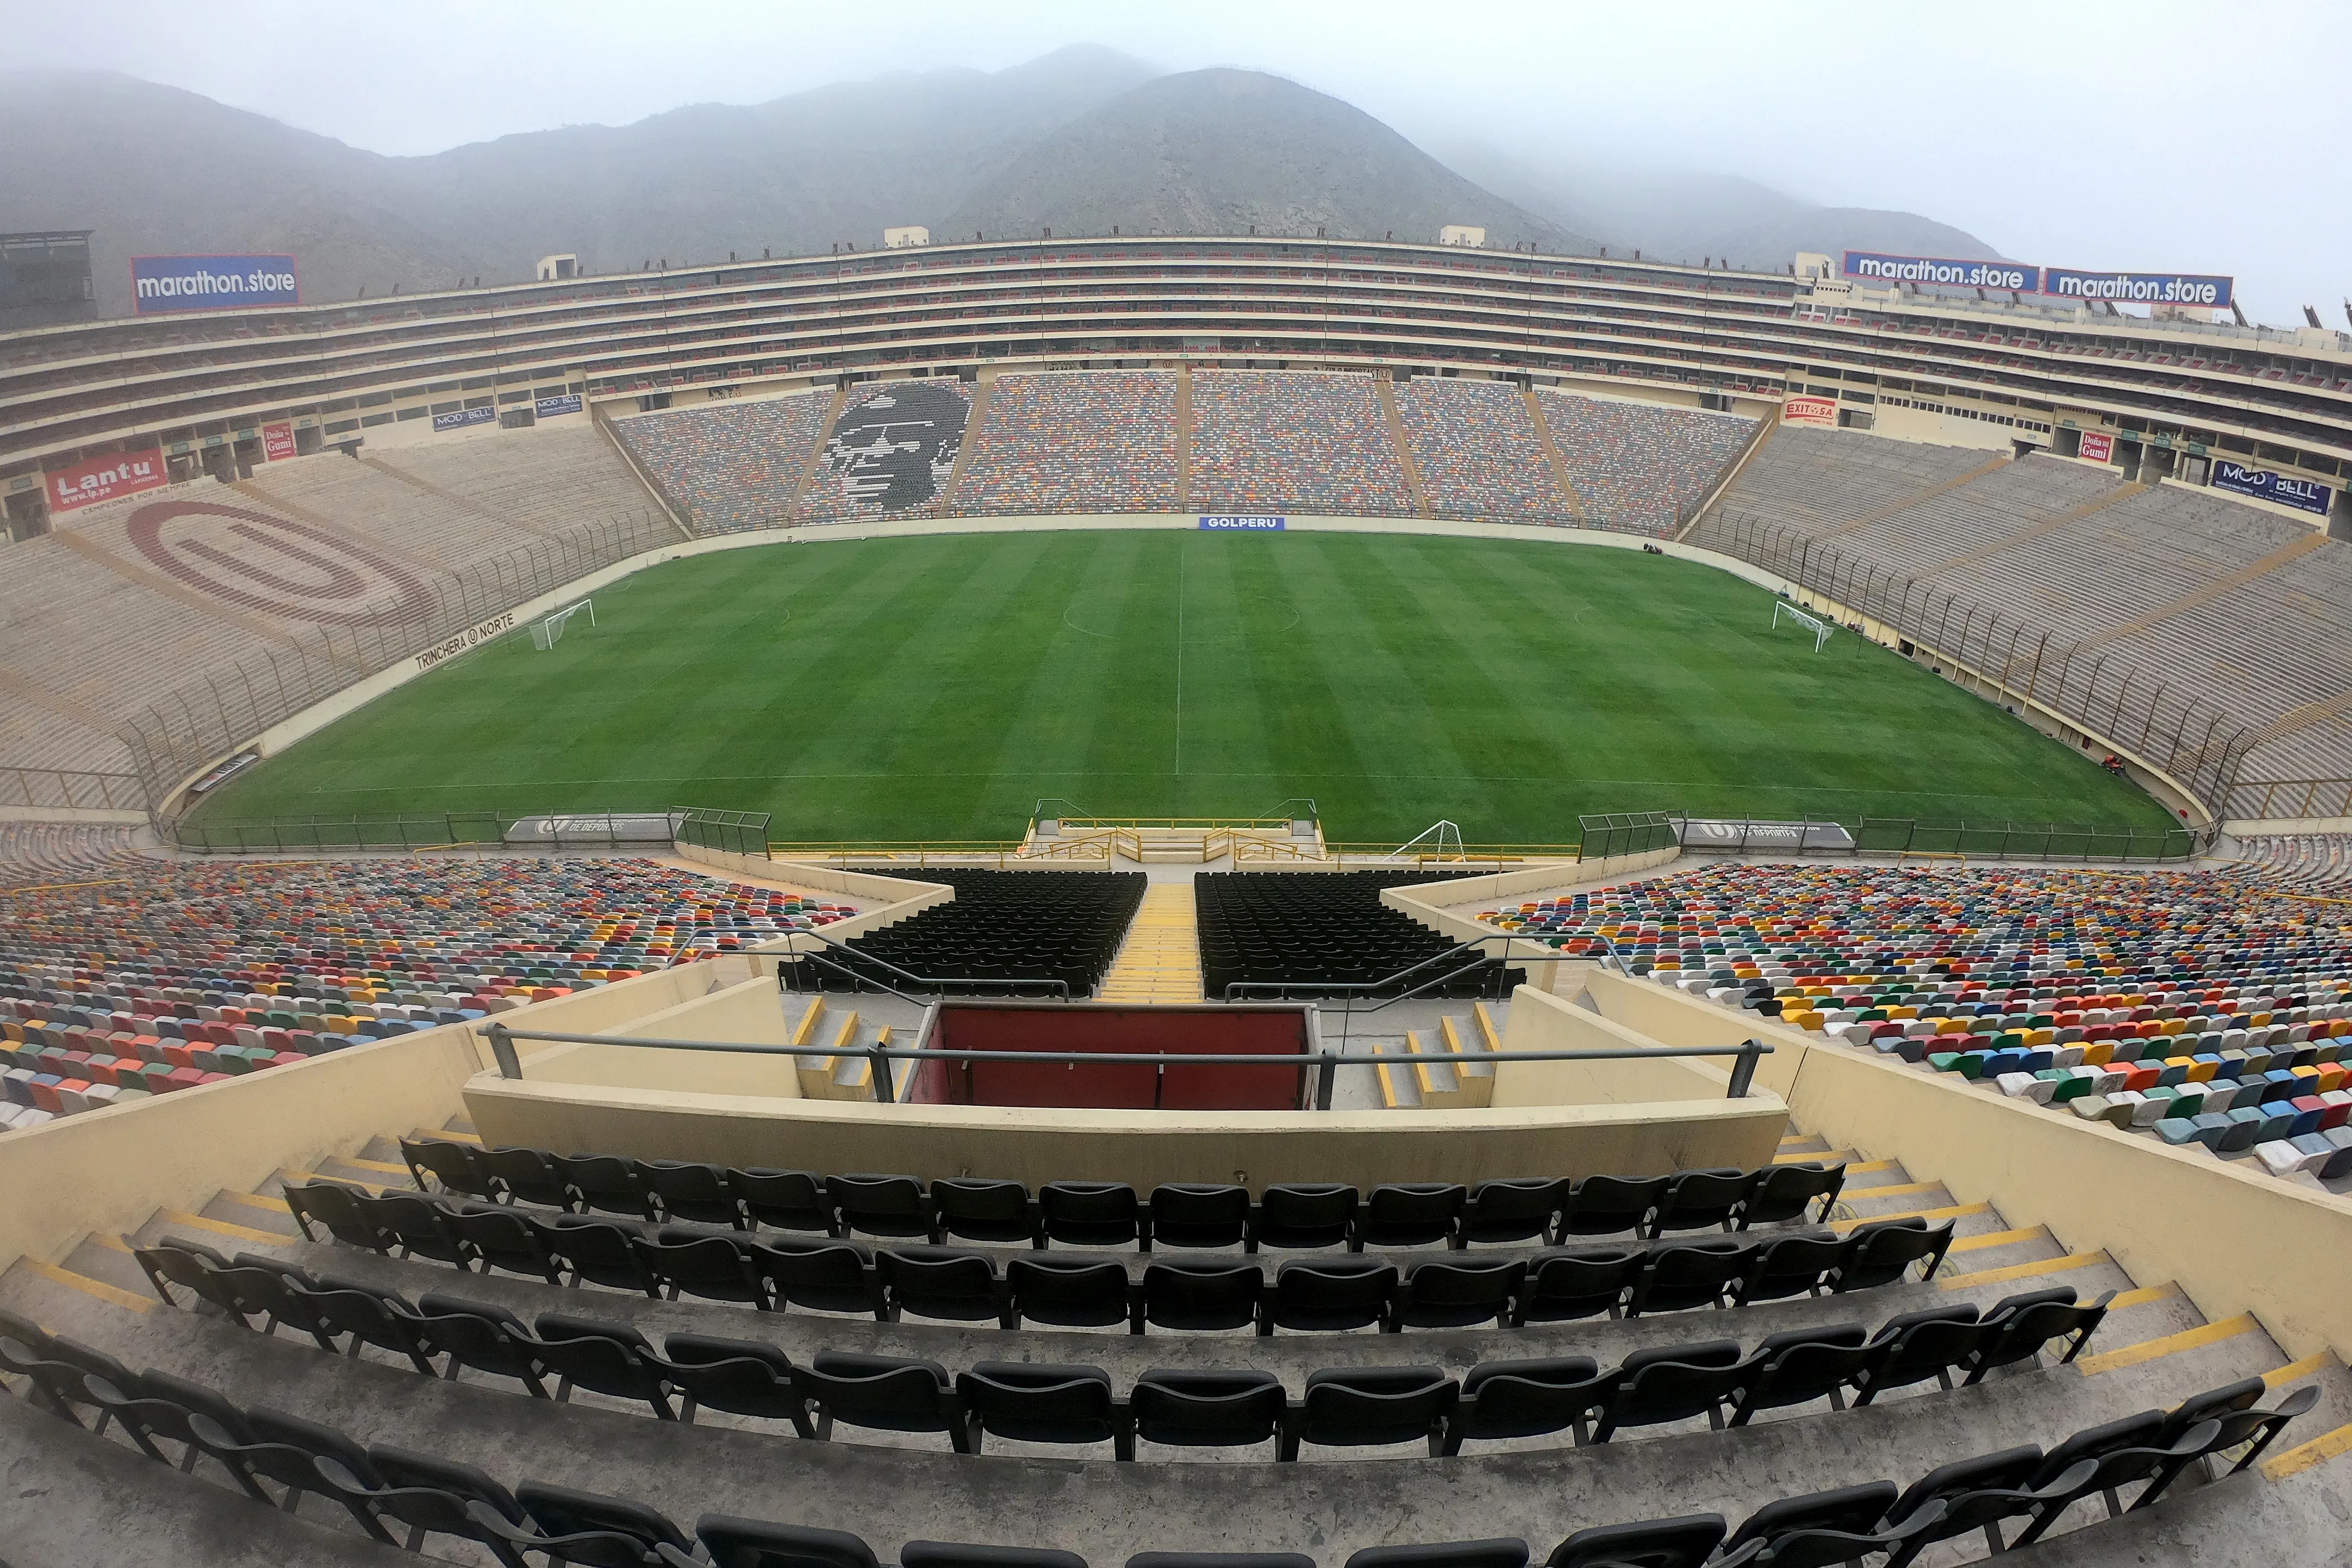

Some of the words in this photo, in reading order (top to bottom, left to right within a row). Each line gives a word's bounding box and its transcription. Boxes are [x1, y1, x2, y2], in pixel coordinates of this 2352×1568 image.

[1859, 259, 2024, 289] marathon.store
[137, 269, 295, 298] marathon.store
[2059, 276, 2217, 303] marathon.store
[537, 399, 558, 408] MOD
[563, 396, 581, 404] BELL
[437, 413, 463, 425] MOD
[468, 409, 492, 419] BELL
[266, 430, 284, 440] Doña
[2084, 435, 2102, 446] Doña
[267, 437, 292, 452] Gumi
[2082, 444, 2107, 459] Gumi
[56, 461, 151, 496] Lantu
[2276, 480, 2317, 500] BELL
[1208, 518, 1277, 528] GOLPERU
[415, 635, 467, 670] TRINCHERA
[479, 613, 514, 640] NORTE
